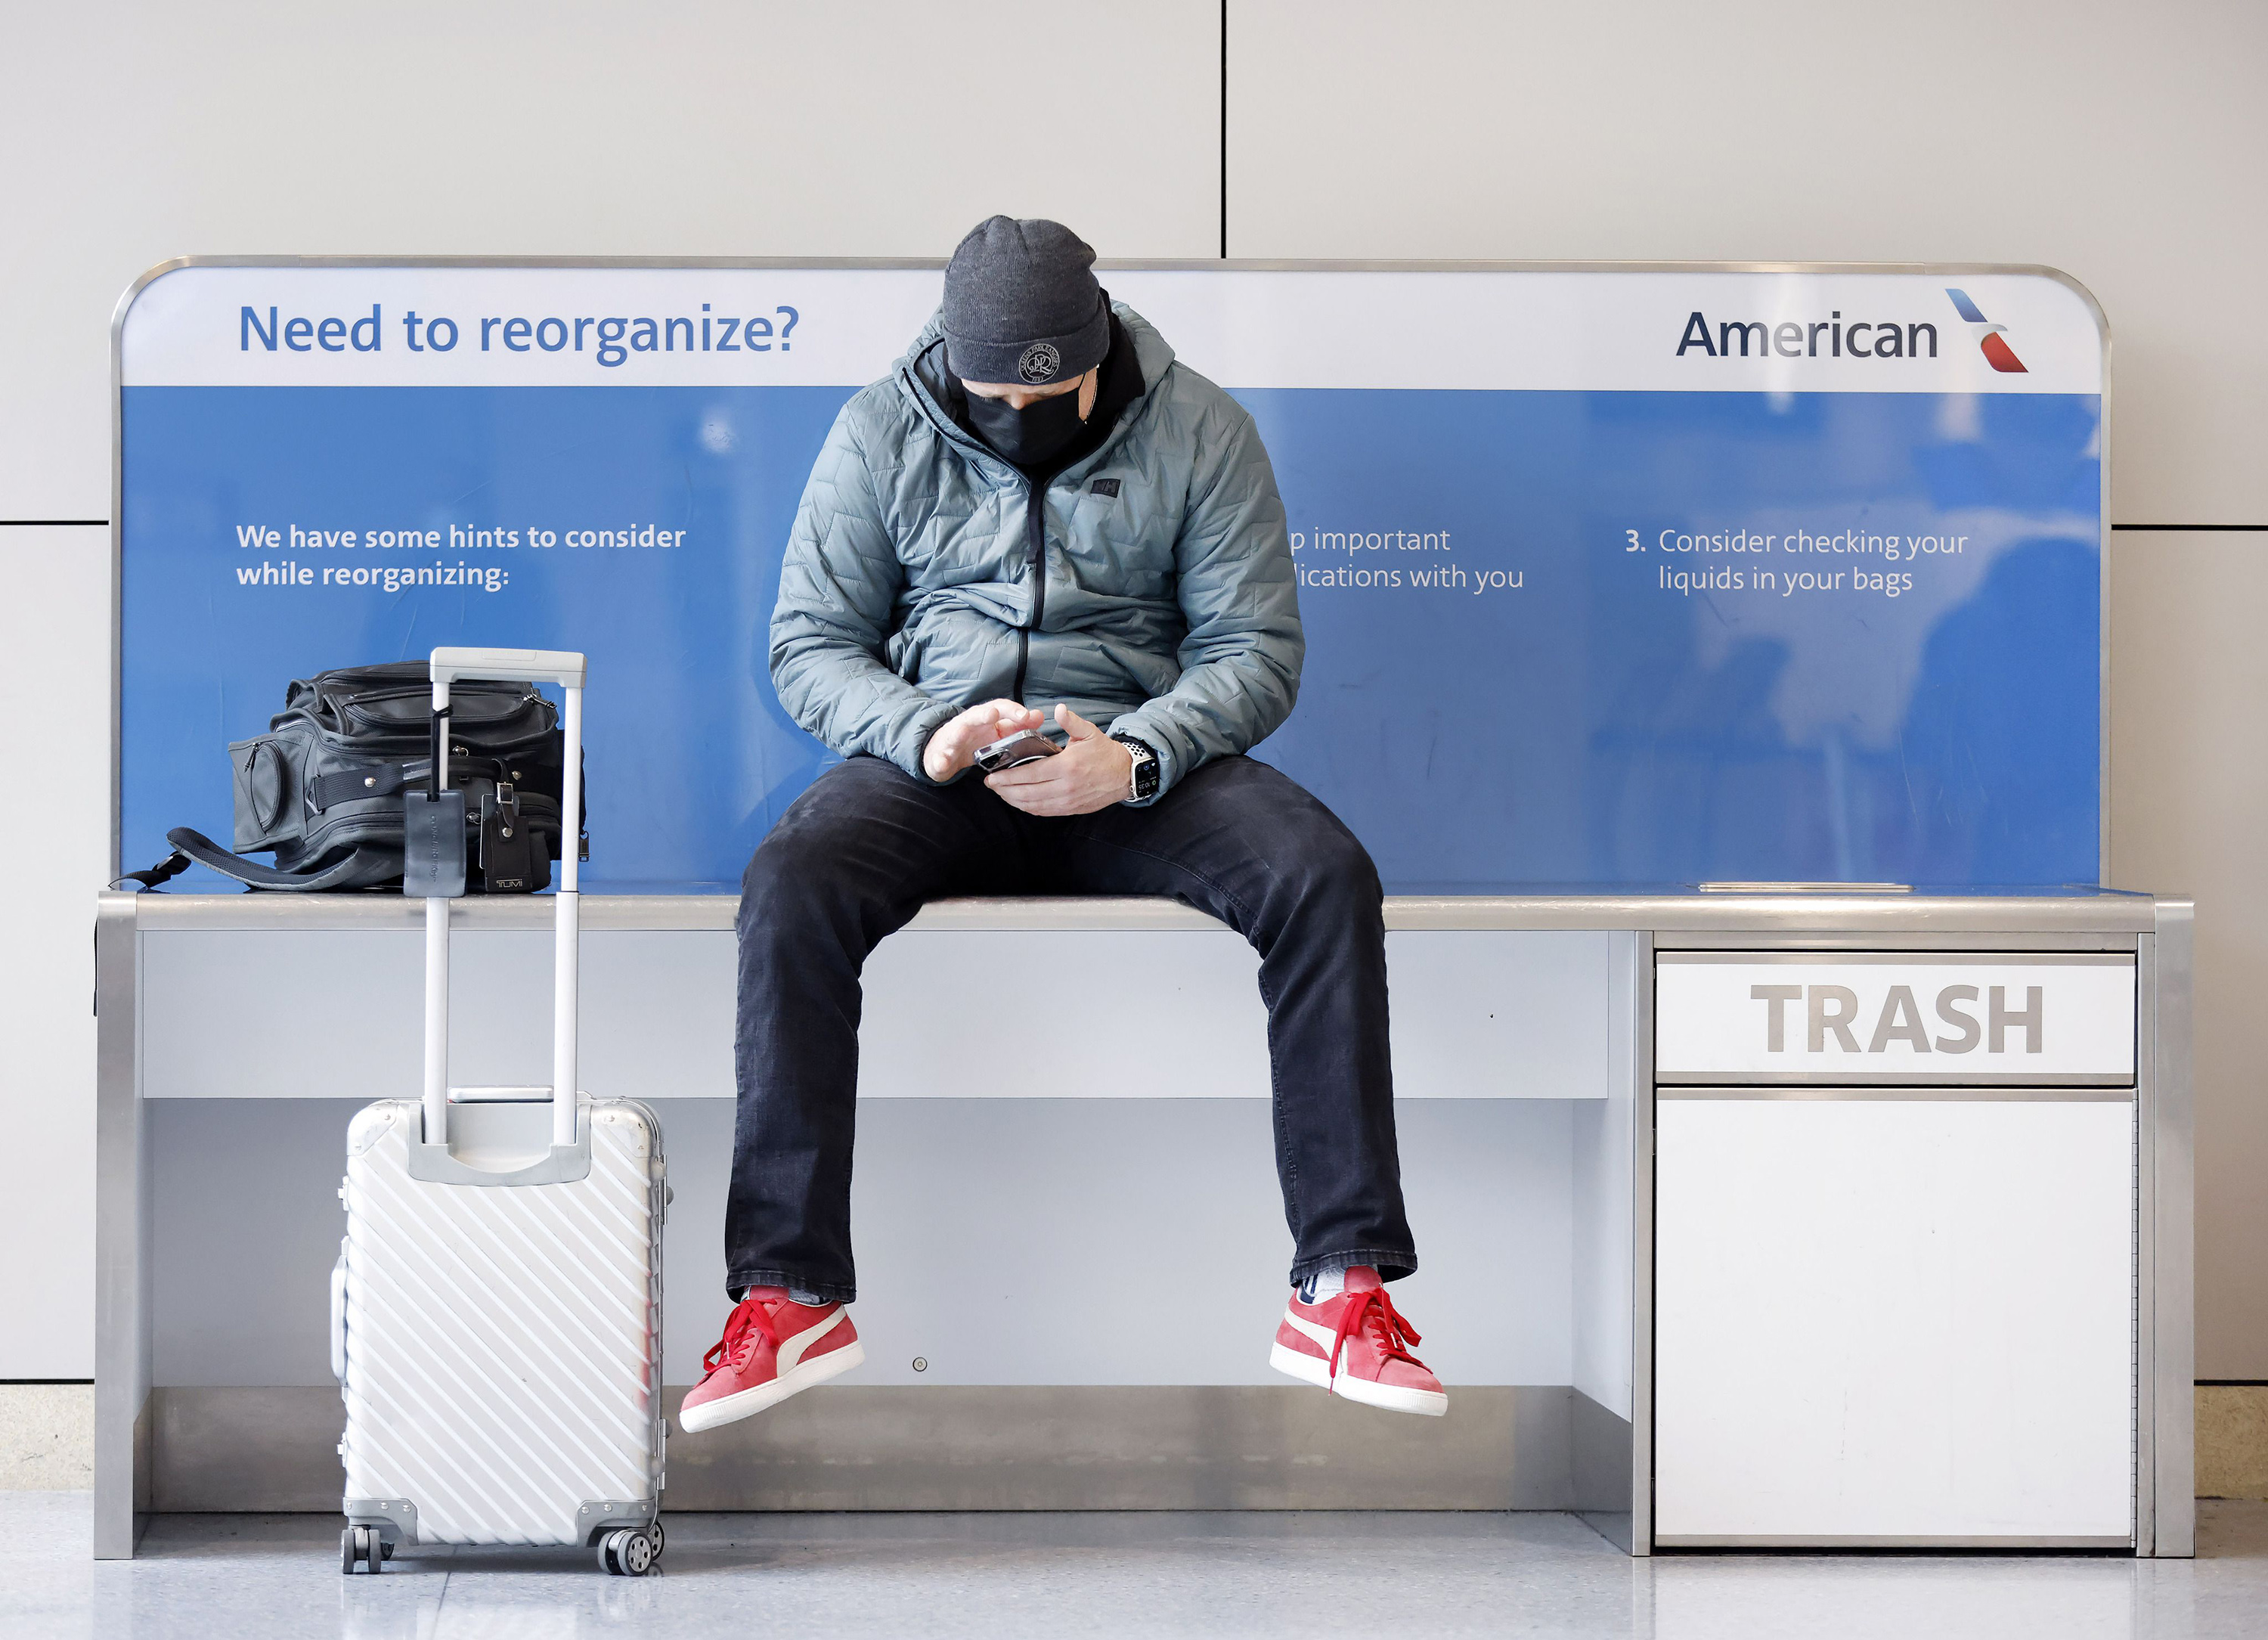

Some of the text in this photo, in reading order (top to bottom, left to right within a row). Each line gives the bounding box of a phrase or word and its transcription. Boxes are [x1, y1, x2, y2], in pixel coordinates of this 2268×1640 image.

[241, 303, 799, 367] Need to reorganize?
[1676, 311, 1938, 358] American
[237, 524, 686, 547] We have some hints to consider
[1315, 526, 1451, 556] important
[1626, 529, 1969, 561] 3. Consider checking your
[237, 561, 509, 592] while reorganizing:
[1409, 563, 1467, 587] with
[1474, 570, 1523, 595] you
[1659, 565, 1913, 598] liquids in your bags
[1751, 985, 2043, 1054] TRASH
